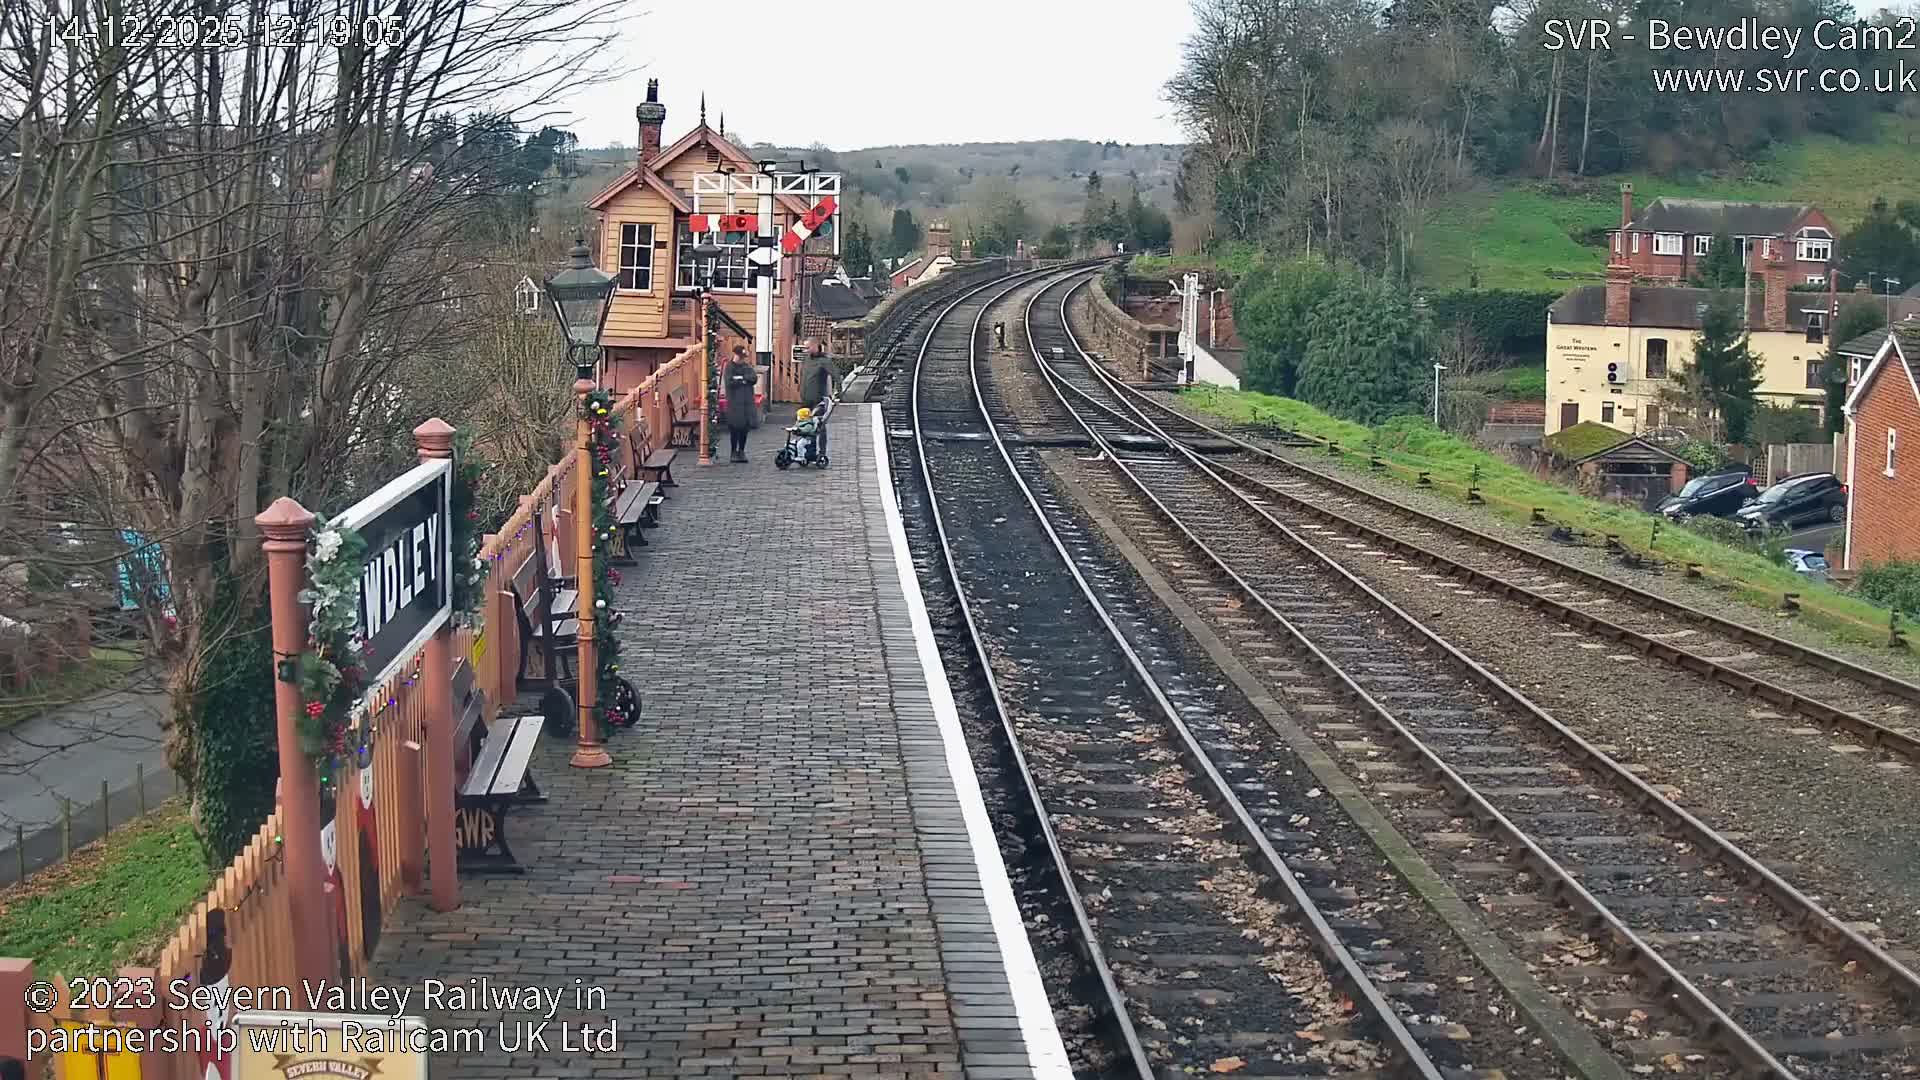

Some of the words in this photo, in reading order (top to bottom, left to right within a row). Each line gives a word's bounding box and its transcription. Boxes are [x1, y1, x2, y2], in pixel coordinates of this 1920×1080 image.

[364, 512, 438, 640] WDLEY
[286, 1060, 328, 1079] SEVERN
[328, 1060, 369, 1080] VALLEY
